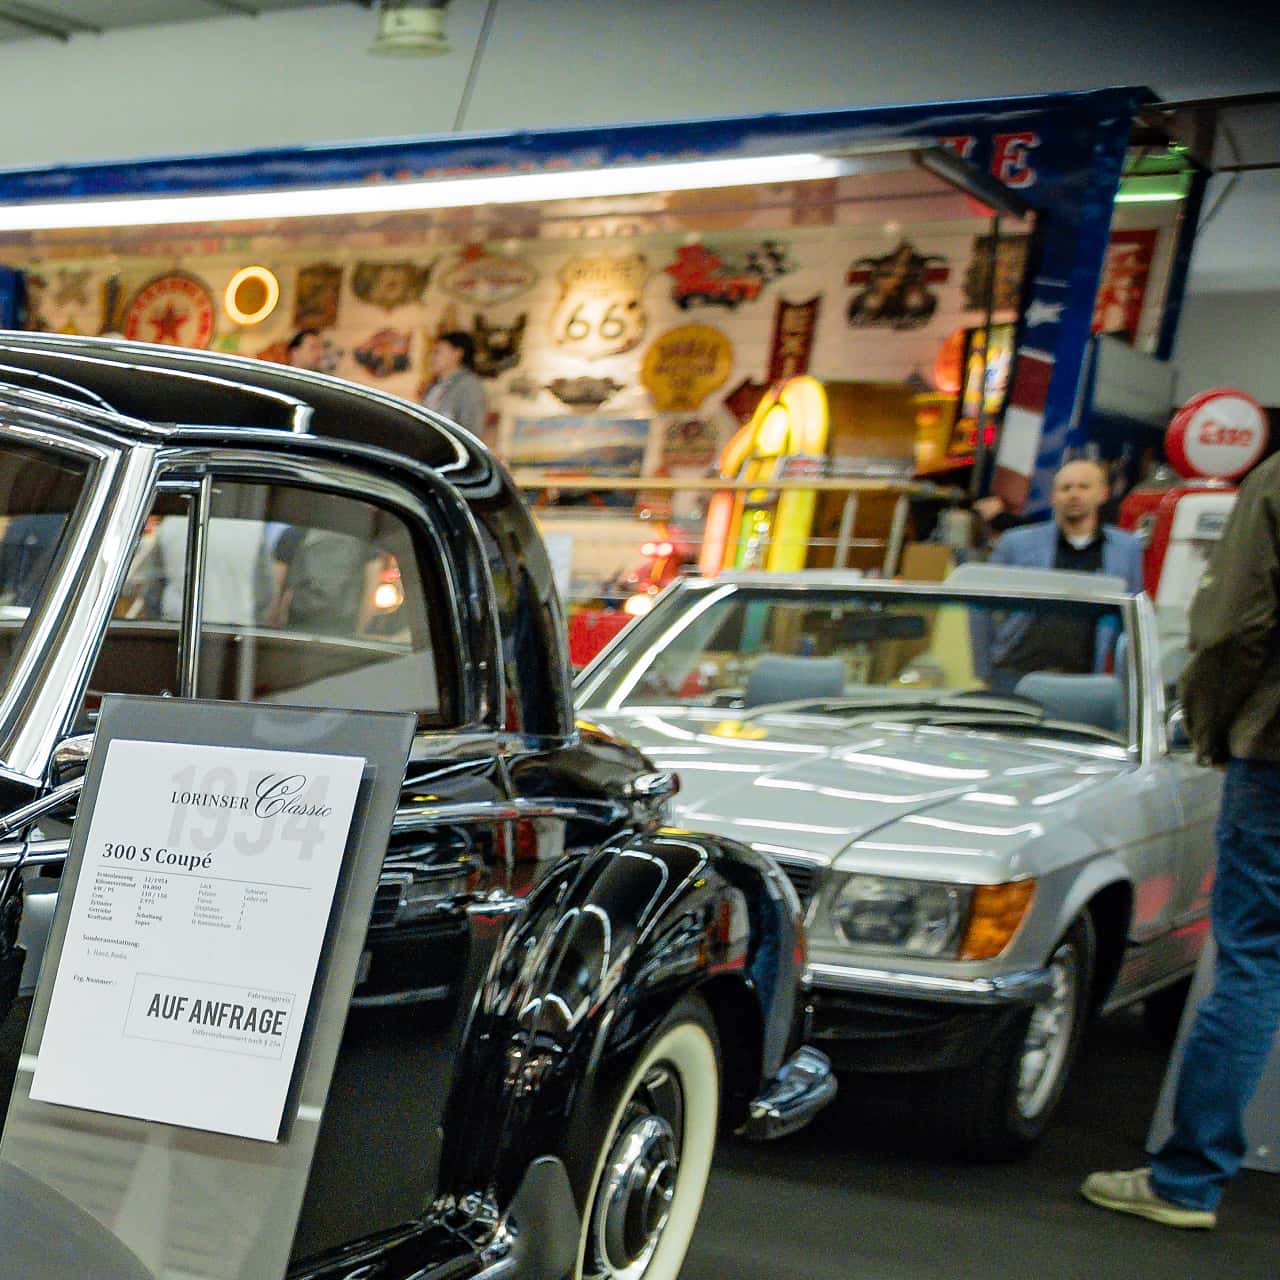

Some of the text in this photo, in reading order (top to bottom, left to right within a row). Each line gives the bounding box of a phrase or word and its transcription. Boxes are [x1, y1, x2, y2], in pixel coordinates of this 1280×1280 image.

[565, 303, 625, 341] 66
[167, 763, 332, 862] 1954
[170, 773, 333, 820] LORINSER Classic
[102, 842, 213, 872] 300 S Coupé
[147, 993, 288, 1036] AUF ANFRAGE
